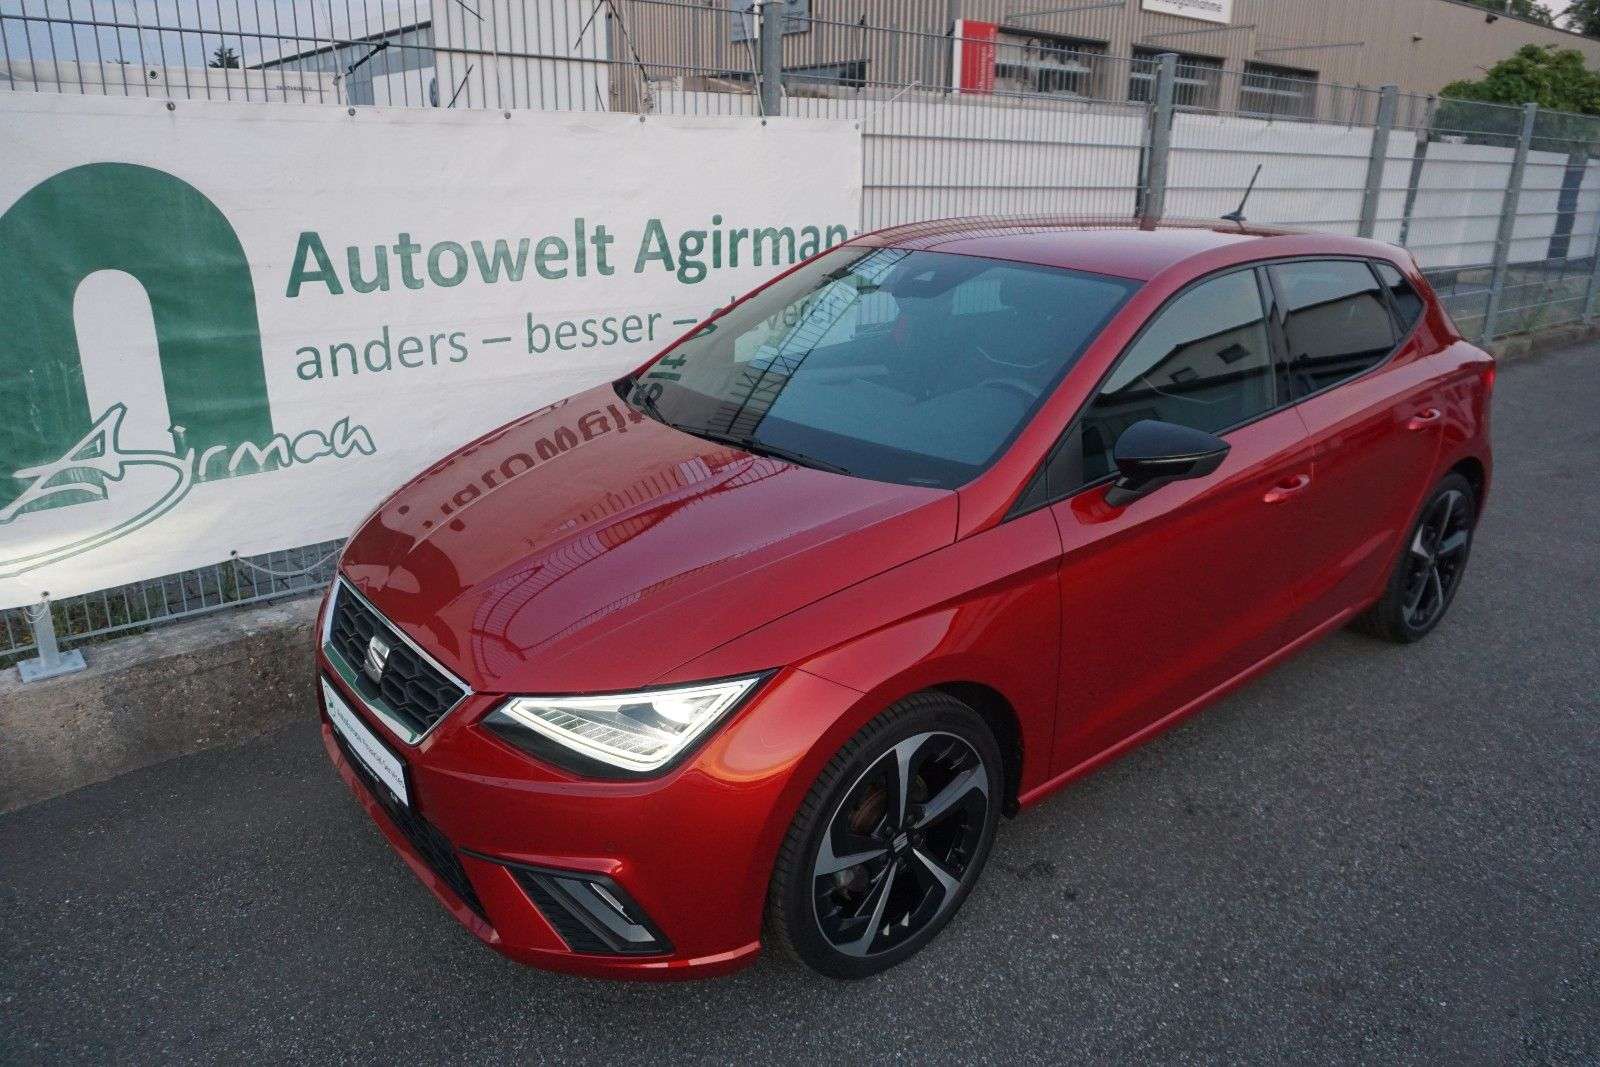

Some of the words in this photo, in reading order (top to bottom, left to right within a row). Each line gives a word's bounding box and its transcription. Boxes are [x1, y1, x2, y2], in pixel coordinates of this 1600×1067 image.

[285, 217, 614, 298] Autowelt
[634, 214, 848, 284] Agirman
[296, 325, 468, 381] anders
[527, 310, 662, 354] besser
